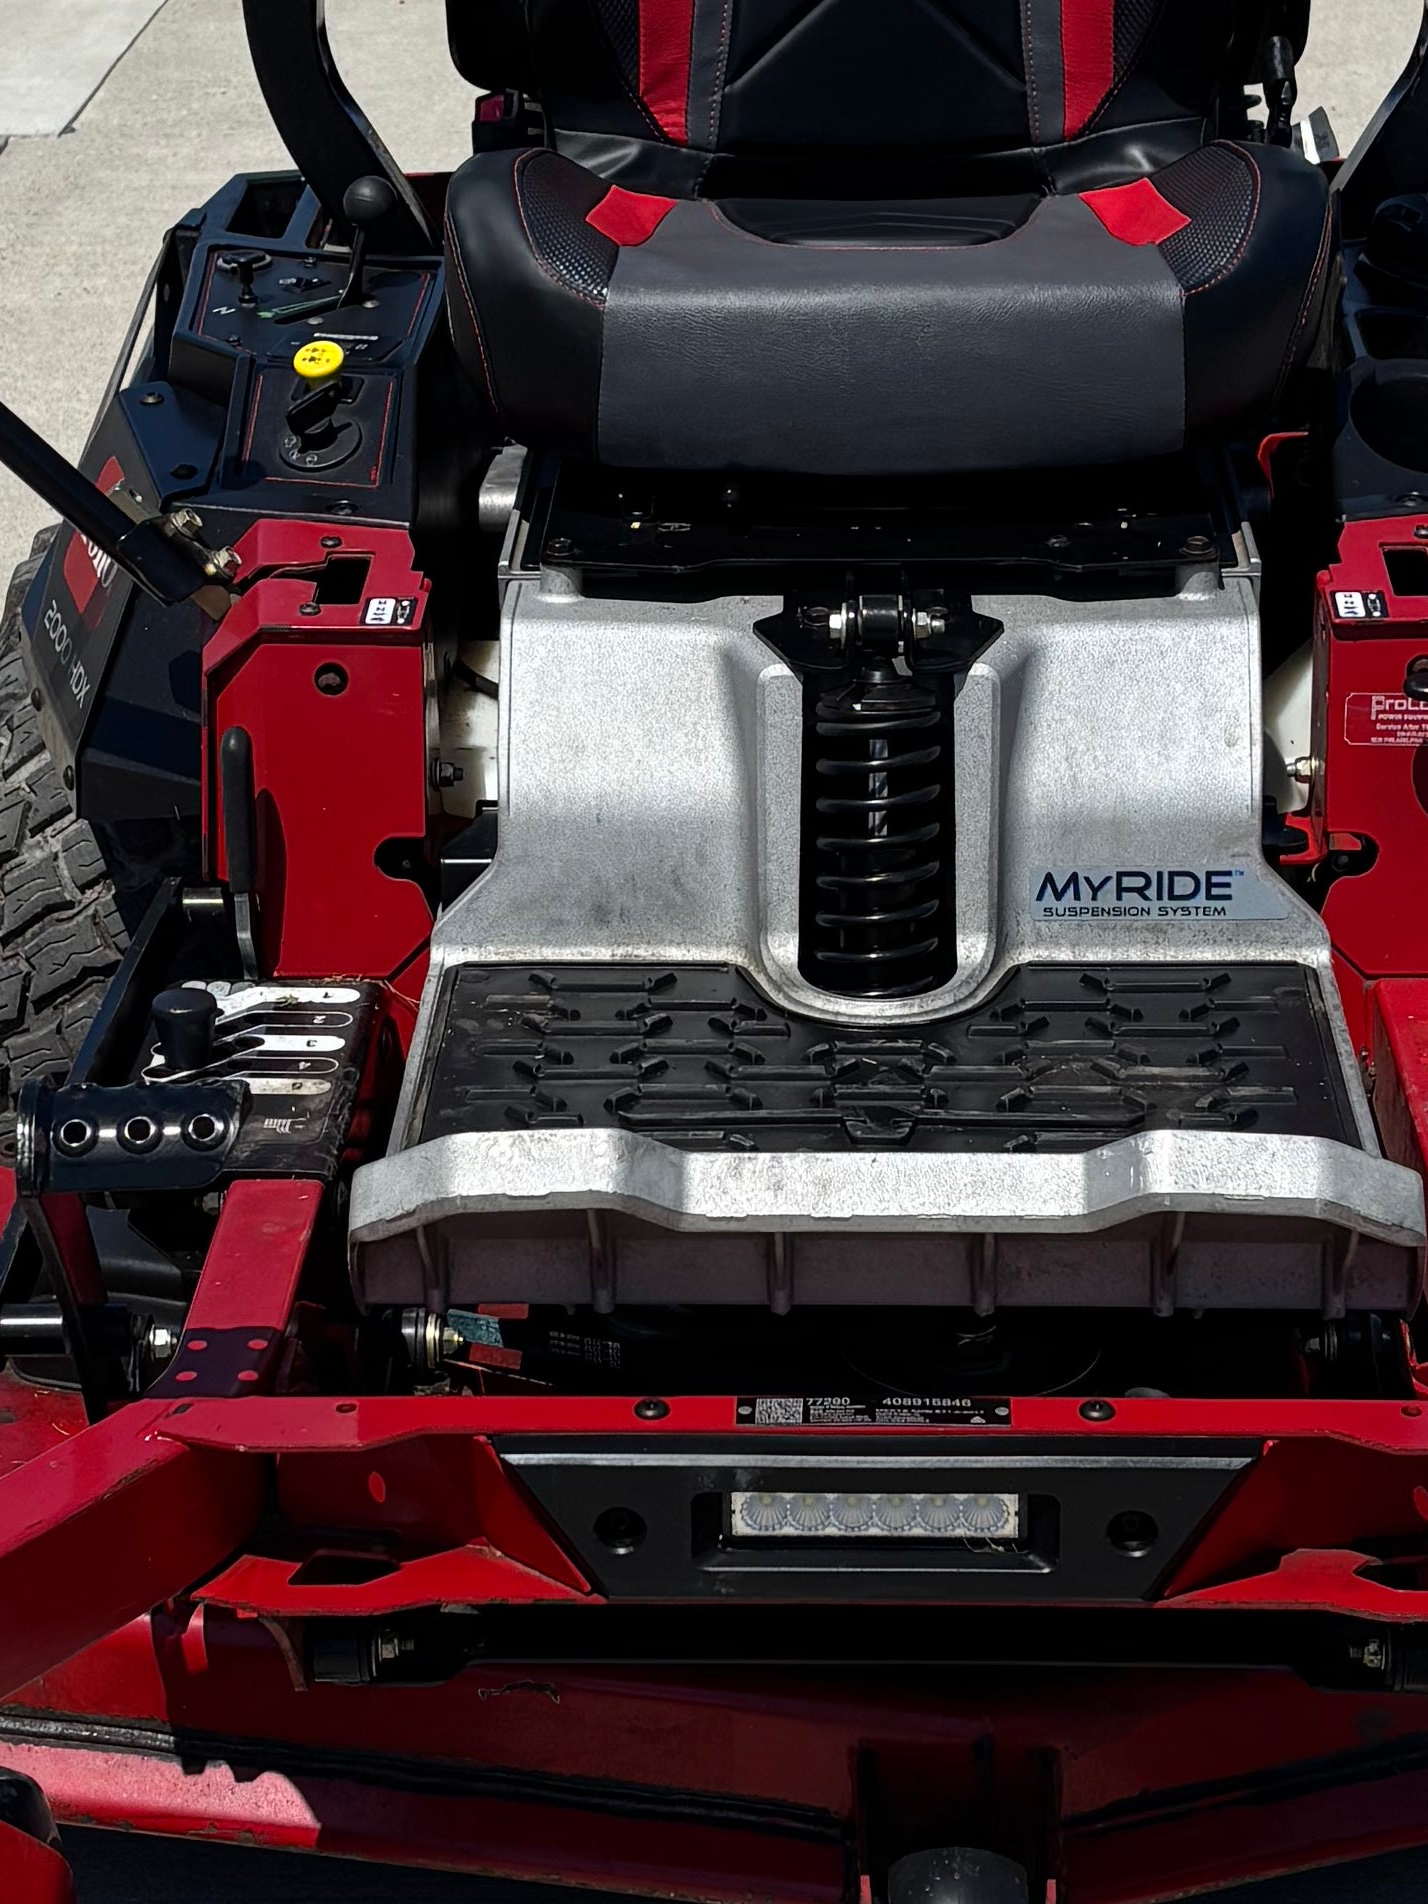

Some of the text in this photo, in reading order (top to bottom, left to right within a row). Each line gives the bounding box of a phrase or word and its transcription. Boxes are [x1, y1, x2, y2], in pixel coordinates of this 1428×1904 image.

[44, 599, 91, 709] 2000 HDX
[1043, 906, 1227, 917] SUSPENSION SYSTEM
